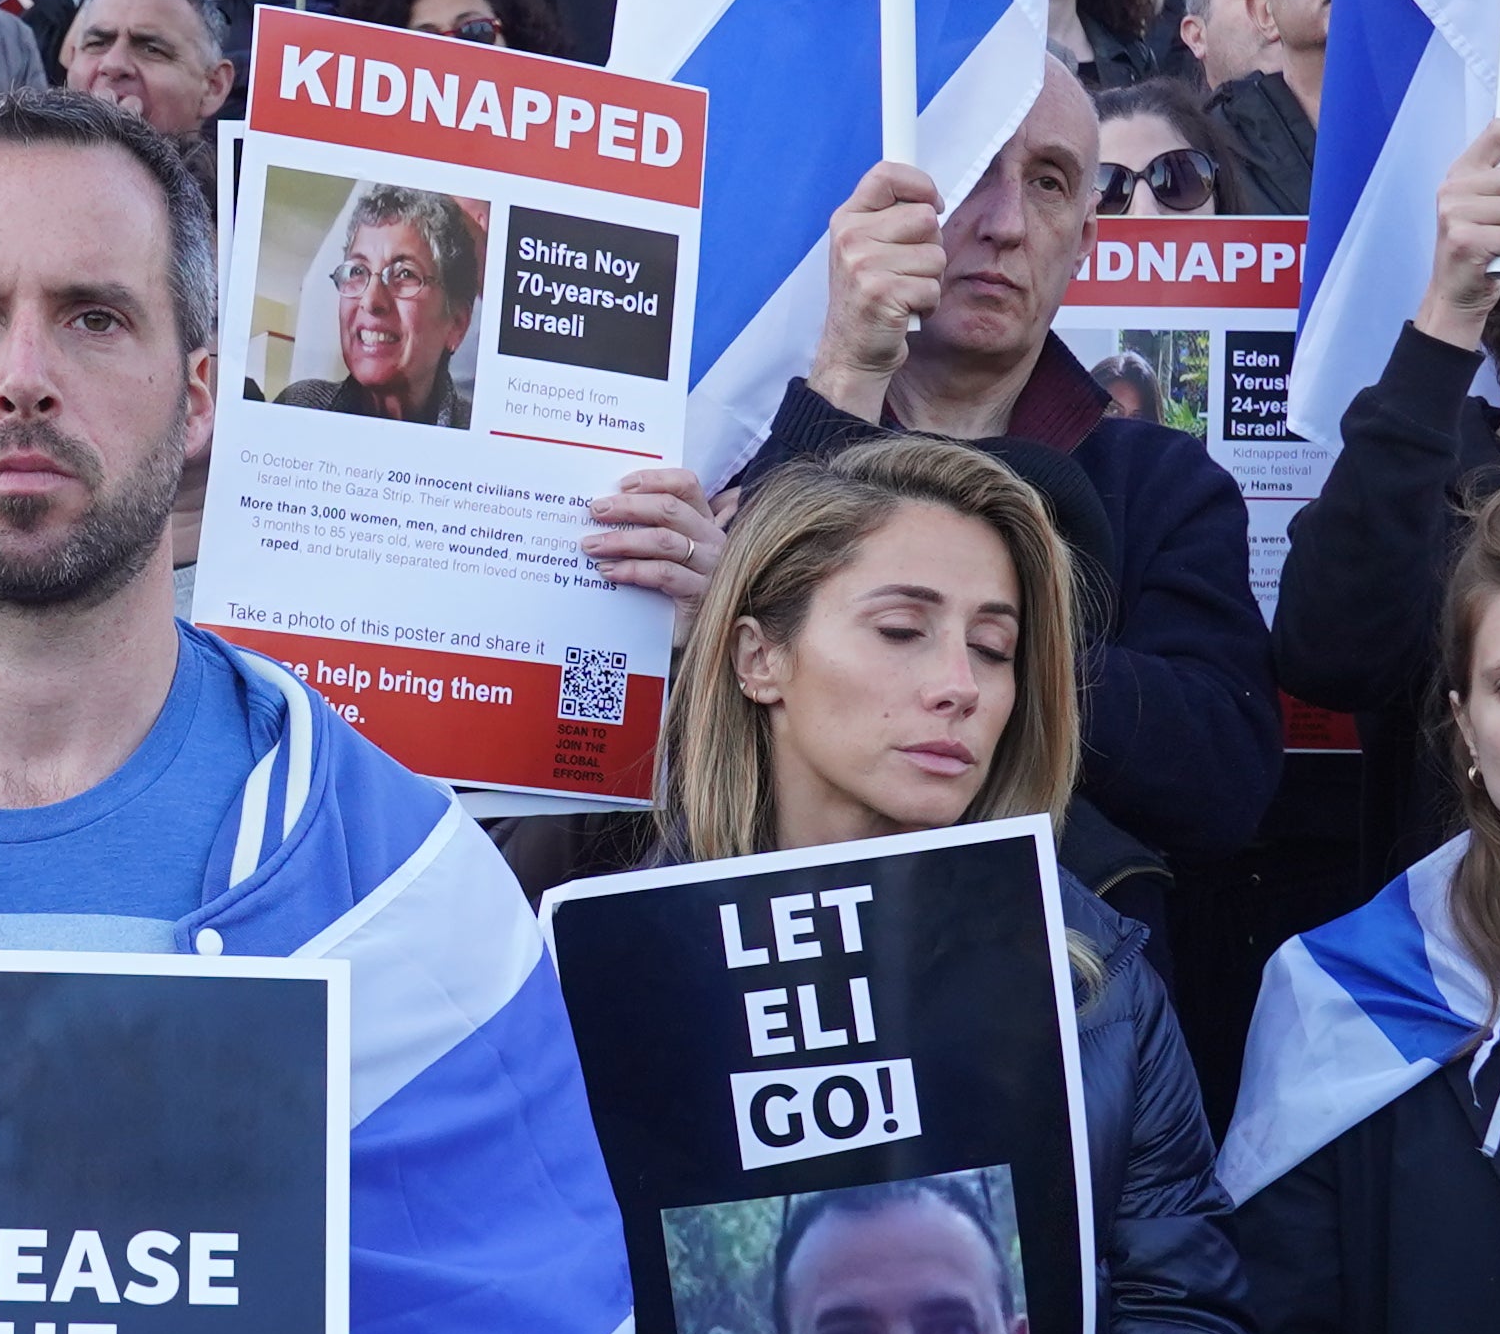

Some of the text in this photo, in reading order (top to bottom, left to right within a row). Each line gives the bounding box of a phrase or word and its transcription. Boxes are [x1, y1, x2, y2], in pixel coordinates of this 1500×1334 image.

[280, 45, 683, 167] KIDNAPPED
[518, 237, 640, 284] Shifra Noy
[517, 270, 658, 316] 70-years-old
[513, 304, 585, 338] Israeli
[1233, 350, 1280, 367] Eden
[1230, 419, 1287, 438] Israeli
[316, 660, 513, 705] help bring them
[719, 885, 873, 968] LET
[744, 977, 875, 1057] ELI
[749, 1067, 898, 1148] GO!
